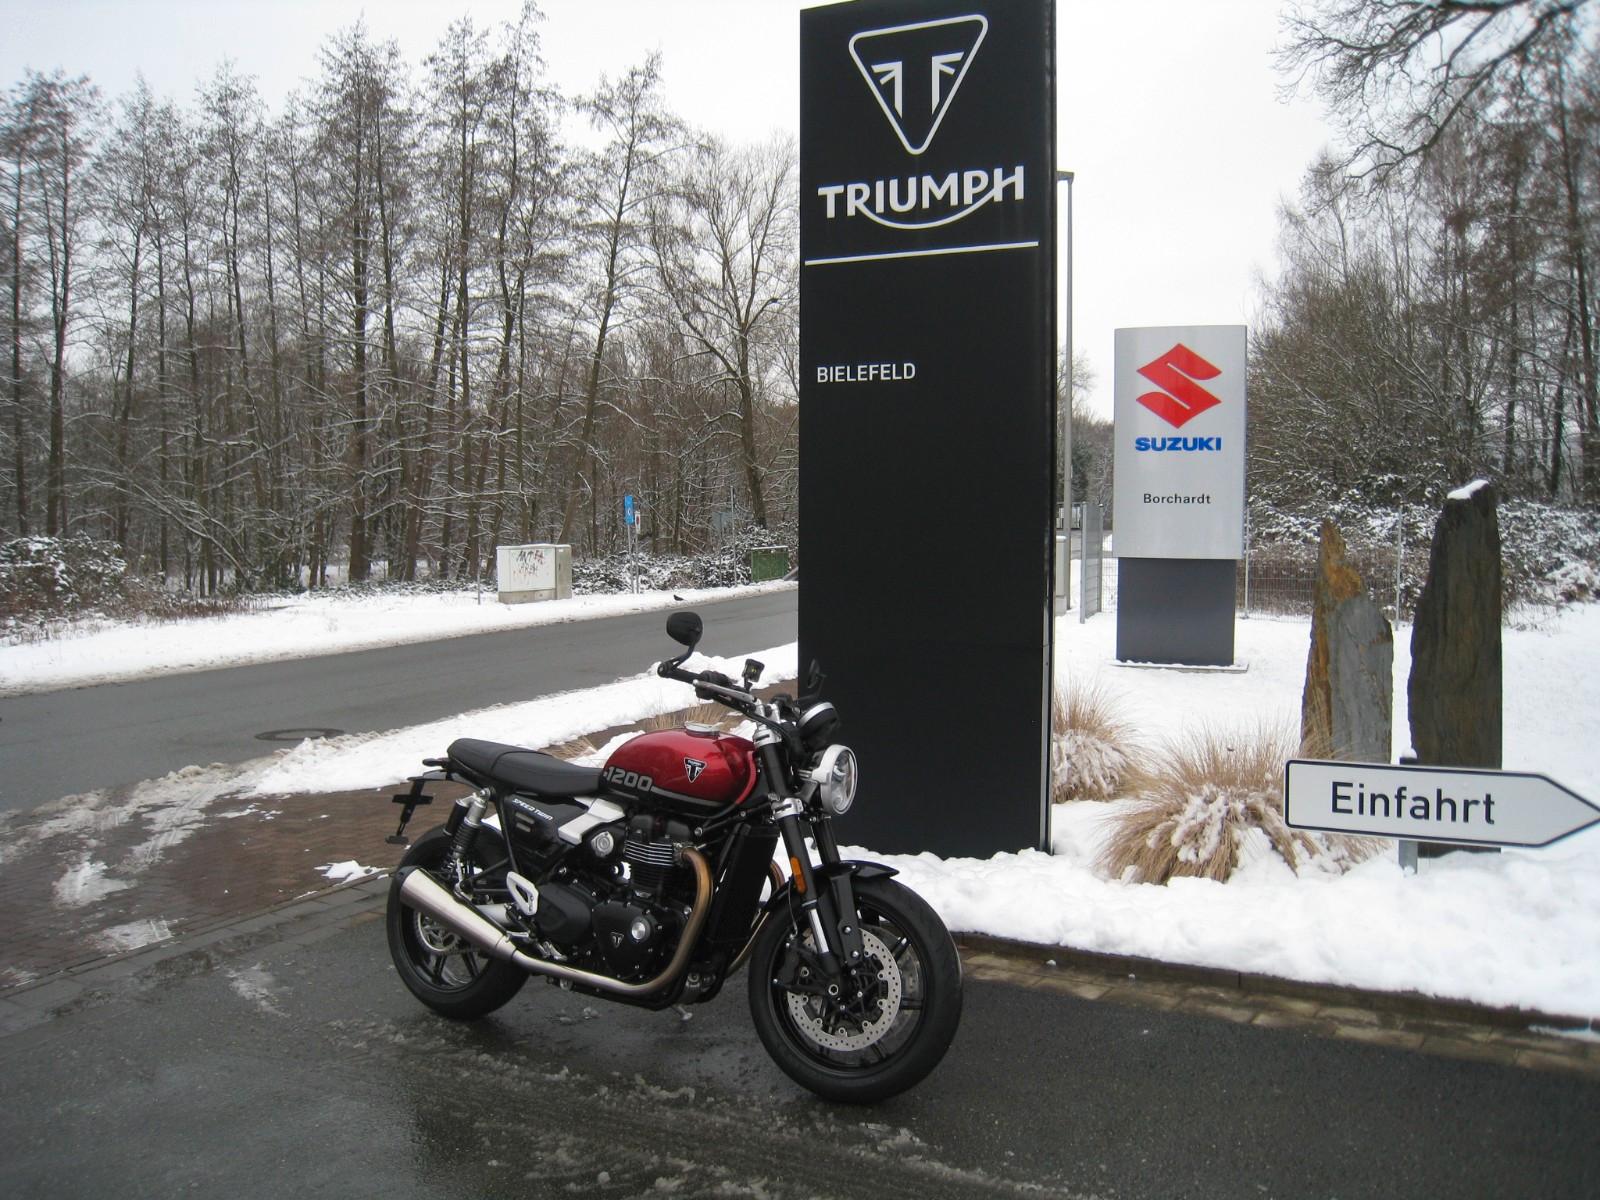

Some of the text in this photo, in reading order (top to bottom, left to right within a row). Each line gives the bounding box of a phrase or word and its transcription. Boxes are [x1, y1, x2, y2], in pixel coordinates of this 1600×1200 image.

[817, 165, 1024, 230] TRIUMPH
[816, 362, 917, 383] BIELEFELD
[1134, 436, 1222, 452] SUZUKI
[1142, 493, 1212, 505] Borchardt
[606, 766, 653, 792] 1200
[1331, 781, 1496, 825] Einfahrt
